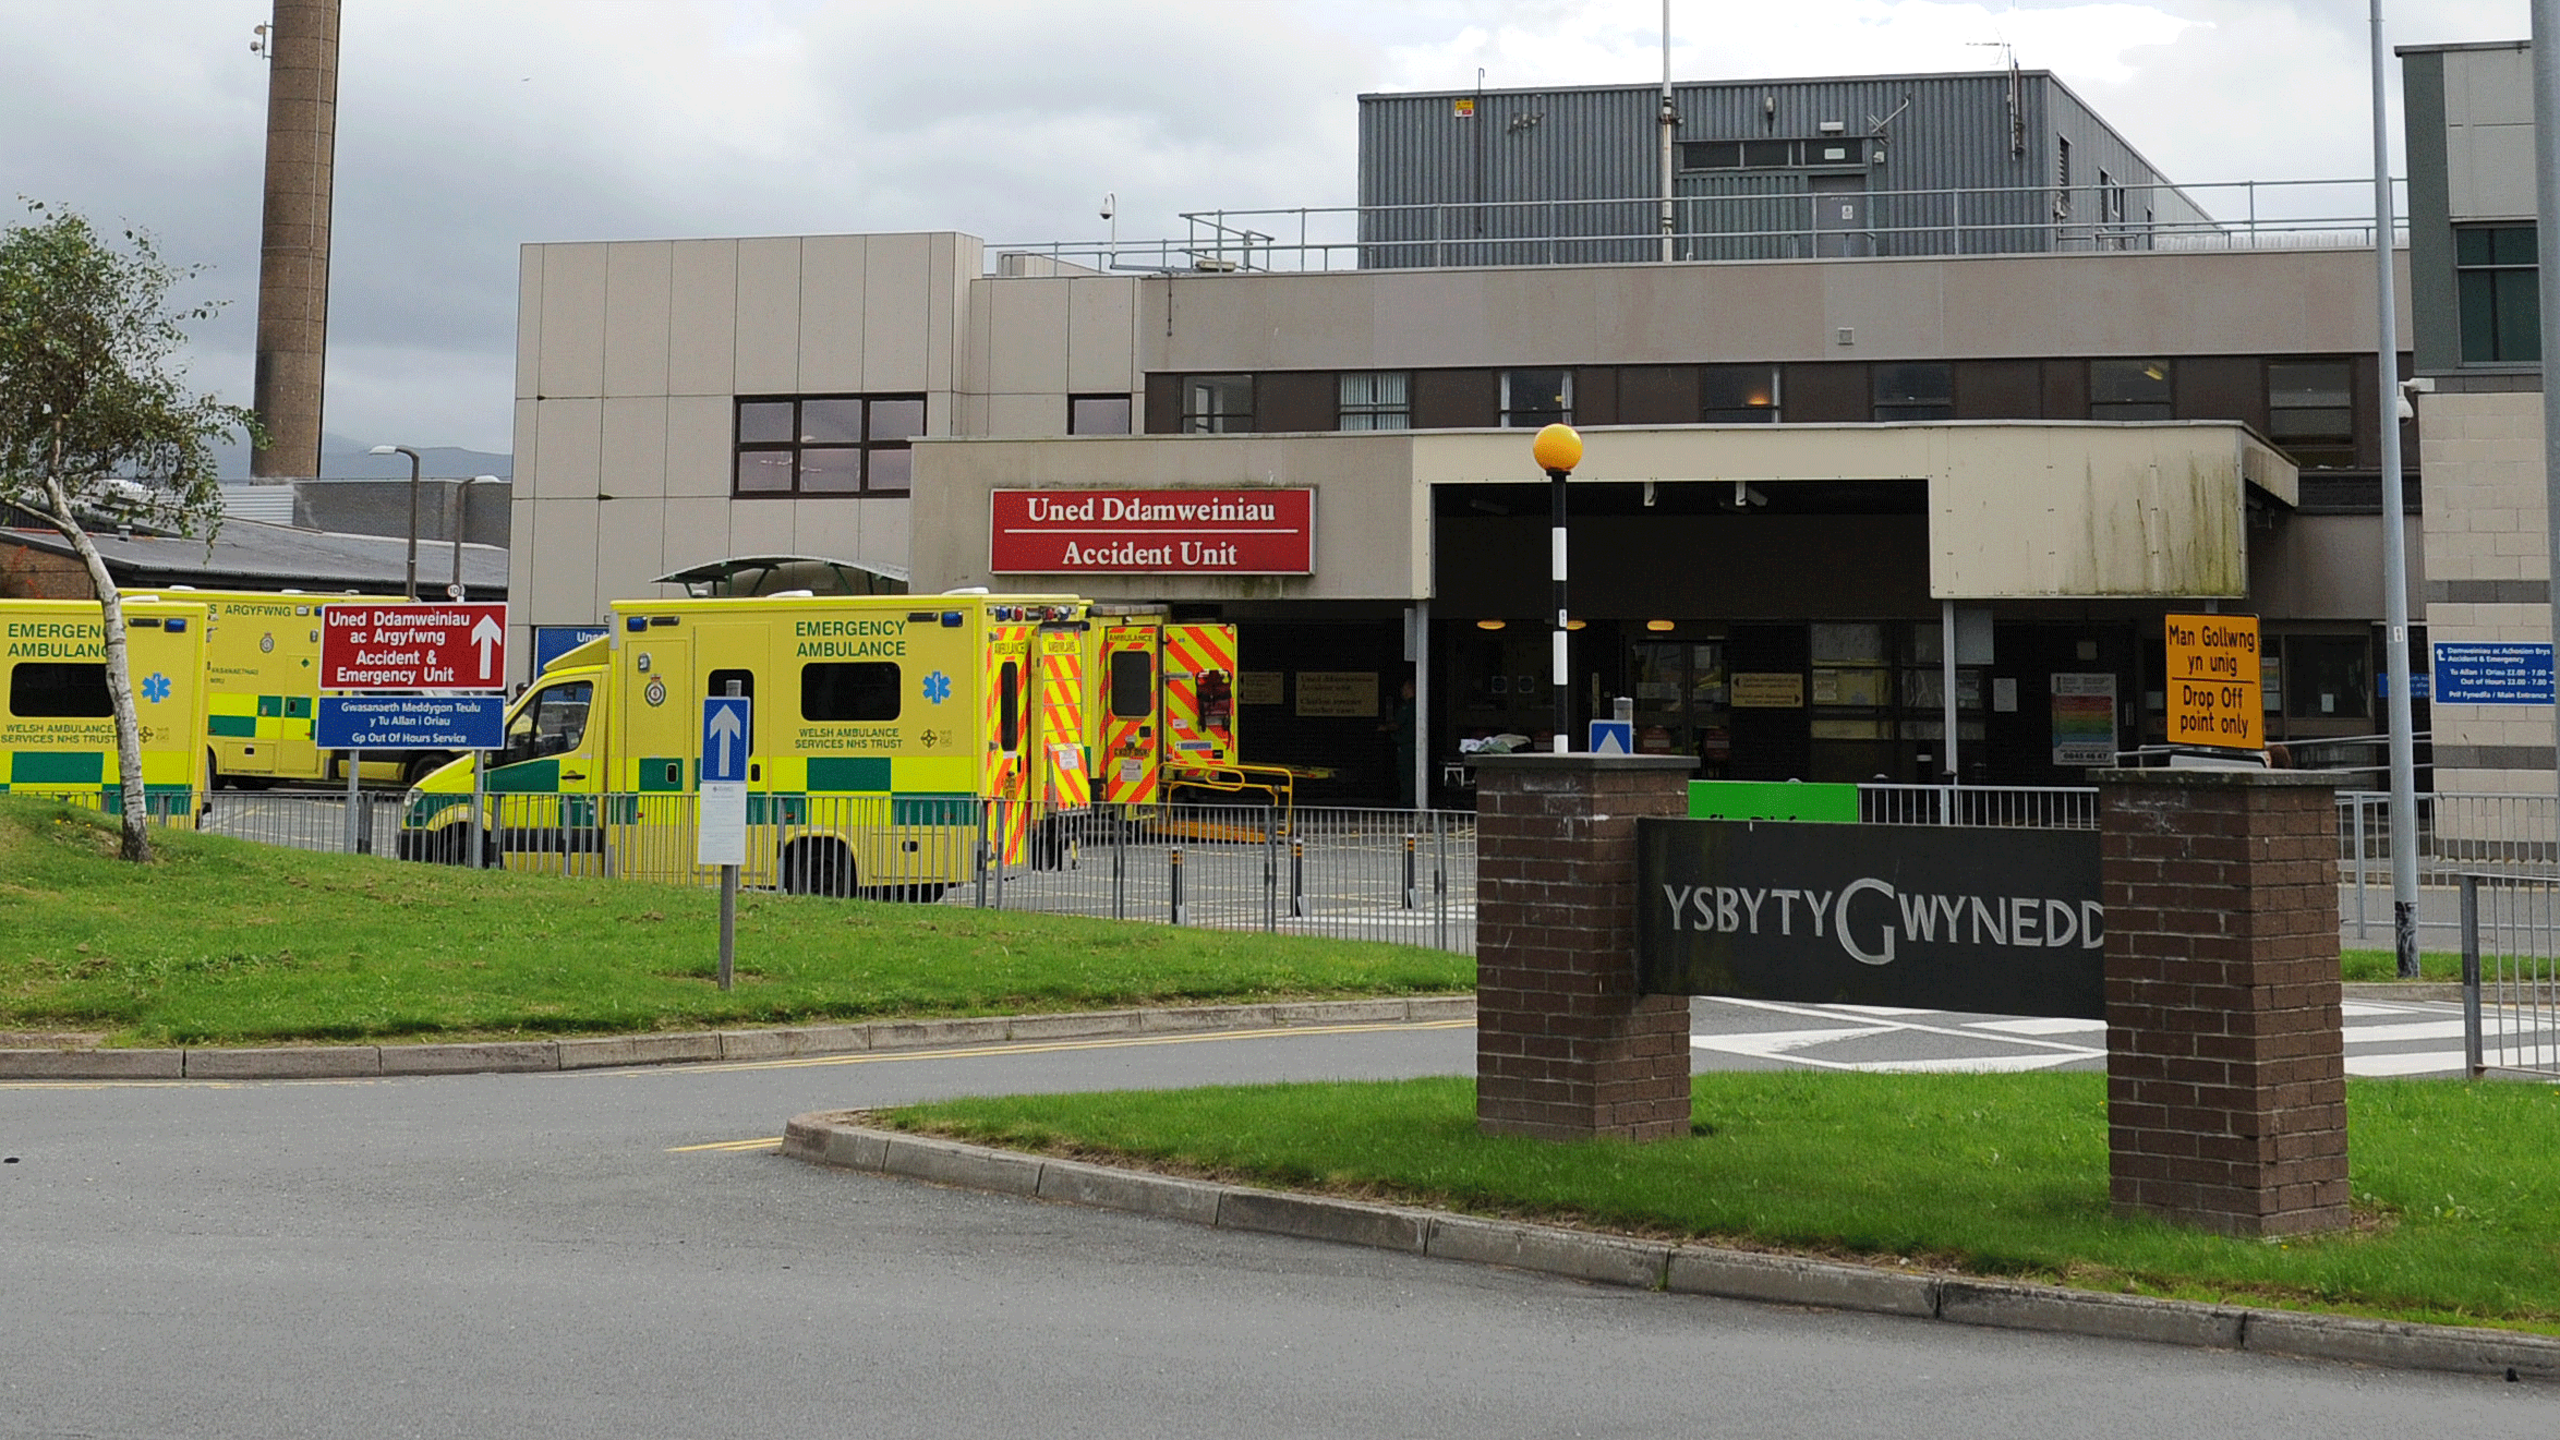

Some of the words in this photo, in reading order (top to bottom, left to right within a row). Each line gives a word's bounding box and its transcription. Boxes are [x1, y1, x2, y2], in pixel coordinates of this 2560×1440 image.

[1027, 498, 1094, 521] Uned
[1102, 497, 1275, 521] Ddamweiniau
[1062, 542, 1172, 565] Accident
[1180, 542, 1238, 565] Unit
[225, 604, 291, 616] ARGYFWNG
[329, 611, 367, 626] Uned
[374, 611, 470, 626] Ddamweiniau
[8, 623, 101, 638] EMERGEN
[796, 620, 906, 636] EMERGENCY
[350, 632, 367, 644] ac
[374, 628, 446, 646] Argyfwng
[2168, 625, 2195, 646] Man
[2202, 625, 2255, 652] Gollwng
[796, 641, 906, 657] AMBULANCE
[356, 650, 420, 665] Accident
[426, 650, 437, 665] &
[2188, 655, 2203, 675] yn
[2210, 651, 2238, 677] unig
[336, 667, 416, 685] Emergency
[424, 667, 454, 682] Unit
[2183, 684, 2214, 710] Drop
[2222, 686, 2243, 709] Off
[341, 702, 399, 712] Gwasanaeth
[402, 702, 453, 714] Meddygon
[455, 702, 481, 712] Teulu
[6, 724, 44, 733] WELSH
[47, 724, 114, 733] AMBULANCE
[370, 718, 376, 728] y
[378, 716, 389, 726] Tu
[391, 716, 416, 726] Allan
[424, 716, 450, 726] Oriau
[2180, 710, 2214, 734] point
[2221, 712, 2248, 739] only
[0, 734, 54, 743] SERVICES
[57, 734, 80, 743] NHS
[84, 734, 117, 743] TRUST
[352, 733, 366, 744] Gp
[368, 733, 386, 743] Out
[388, 733, 400, 743] Of
[403, 733, 431, 743] Hours
[433, 733, 467, 743] Service
[799, 728, 834, 737] WELSH
[836, 728, 899, 737] AMBULANCE
[795, 739, 844, 748] SERVICES
[846, 739, 868, 748] NHS
[870, 739, 903, 748] TRUST
[1663, 884, 1833, 938] YSBYTY
[1835, 878, 2104, 965] GWYNEDD
